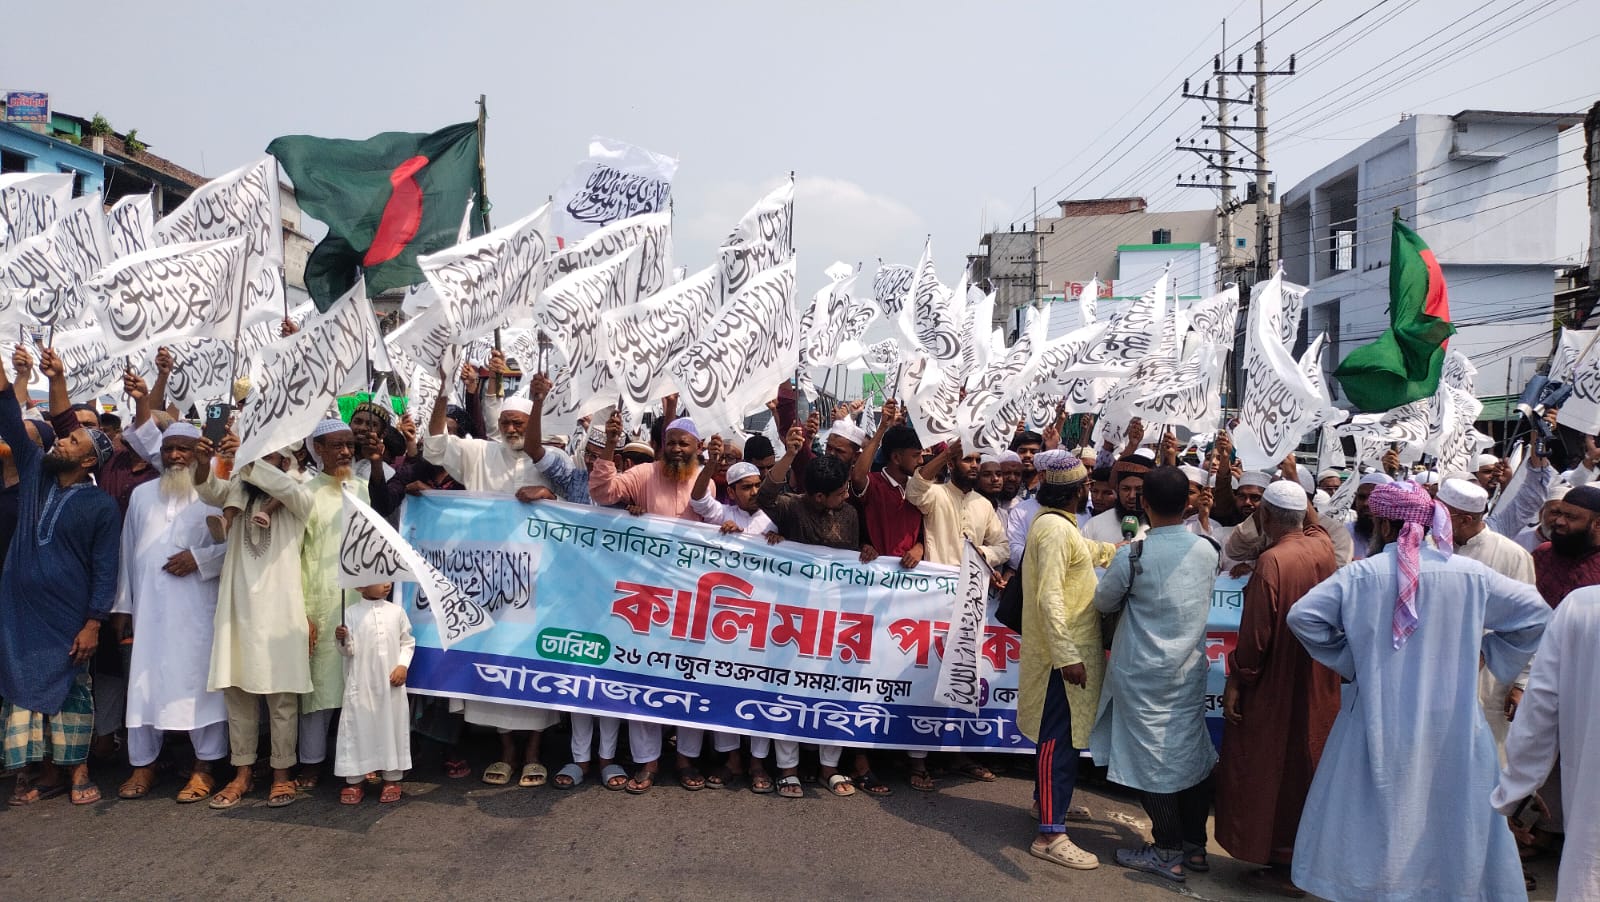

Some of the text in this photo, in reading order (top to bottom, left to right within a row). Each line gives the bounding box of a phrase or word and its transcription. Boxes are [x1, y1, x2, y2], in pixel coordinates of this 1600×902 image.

[527, 517, 598, 548] ঢাকার
[602, 526, 673, 558] হানিফ
[676, 541, 793, 577] ফ্লাইওভারে
[800, 562, 876, 587] কালিমা
[610, 571, 876, 664] কালিমার
[613, 645, 642, 665] ২৬
[647, 651, 670, 670] শে
[675, 654, 711, 680] জুন
[715, 660, 790, 687] শুক্রবার
[876, 678, 913, 702] জুমা
[735, 695, 899, 737] তৌহিদী
[907, 715, 1022, 744] জনতা,
